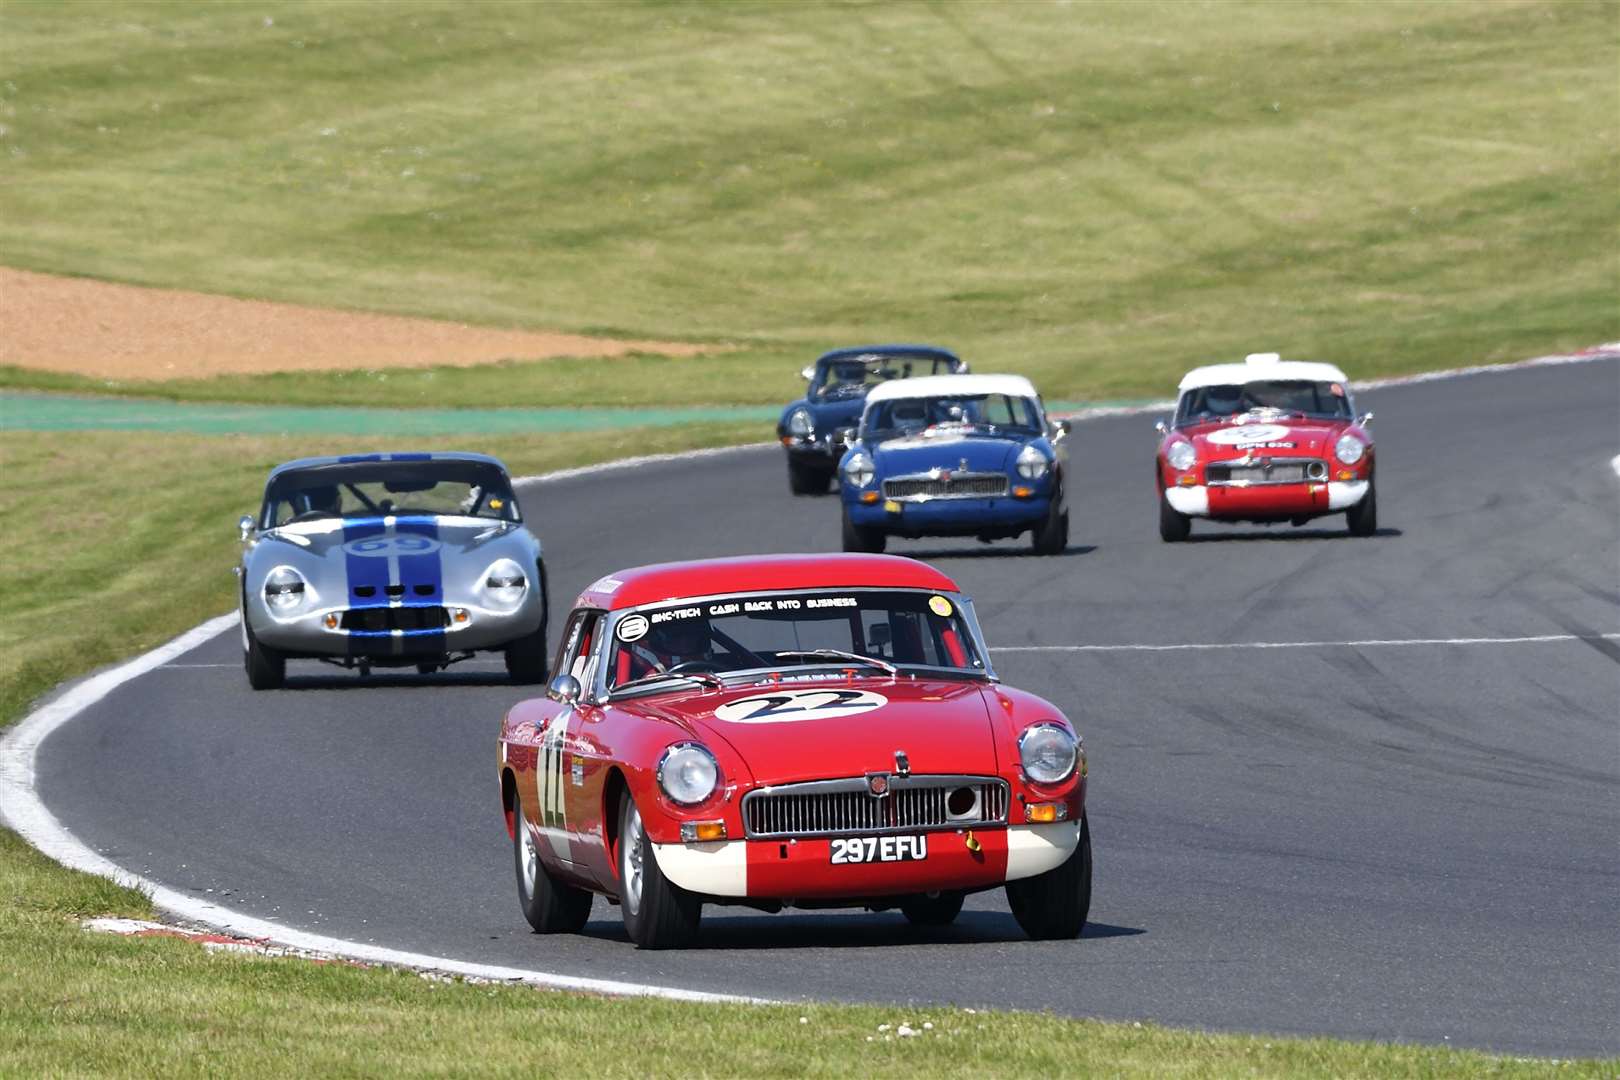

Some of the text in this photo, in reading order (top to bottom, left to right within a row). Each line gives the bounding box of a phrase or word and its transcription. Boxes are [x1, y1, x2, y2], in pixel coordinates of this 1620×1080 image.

[352, 537, 430, 552] 69
[651, 597, 857, 623] BHC-TECH CASH BACK INTO BUSINESS
[725, 691, 878, 720] 22
